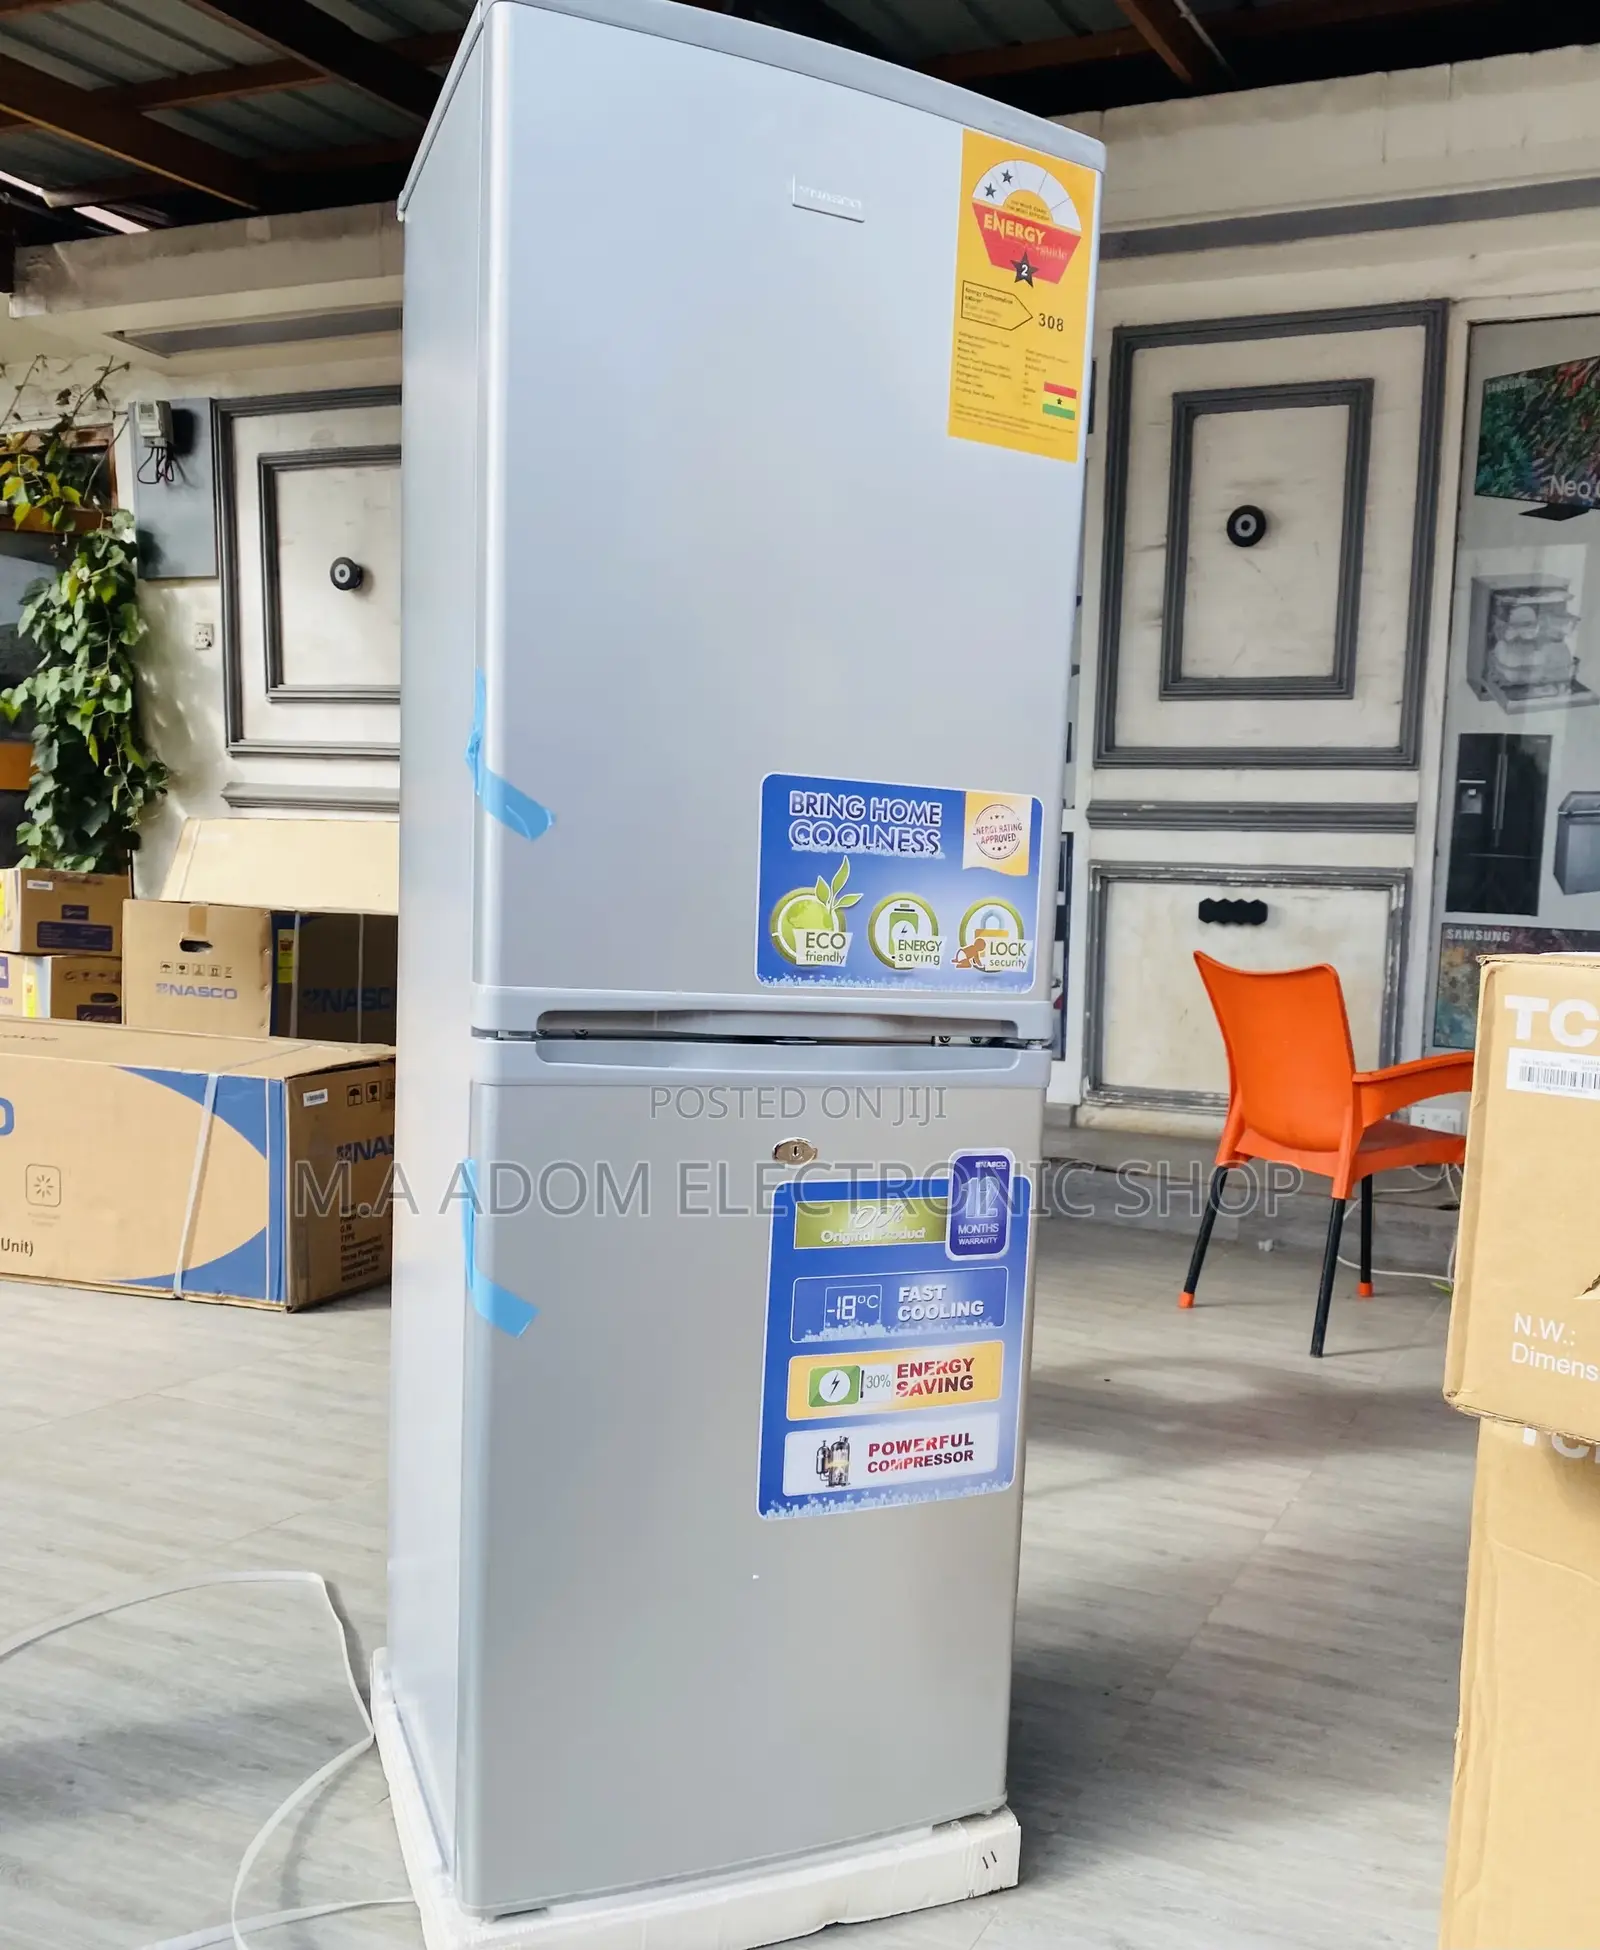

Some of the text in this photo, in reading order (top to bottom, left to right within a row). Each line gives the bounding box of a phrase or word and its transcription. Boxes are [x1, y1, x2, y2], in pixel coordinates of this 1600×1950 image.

[983, 210, 1047, 245] ENERGY
[1021, 264, 1029, 277] 2
[1038, 312, 1064, 332] 308
[790, 790, 942, 826] BRING HOME
[789, 819, 941, 855] COOLNESS
[980, 832, 1017, 844] APPROVED
[805, 932, 847, 949] ECO
[1446, 928, 1511, 943] SAMSUNG
[897, 939, 943, 952] ENERGY
[989, 942, 1027, 957] LOCK
[805, 950, 846, 965] friendly
[897, 953, 941, 966] saving
[988, 956, 1028, 969] security
[169, 983, 238, 1000] NASCO
[820, 1228, 875, 1245] Original
[958, 1223, 1000, 1235] MONTHS
[0, 1237, 34, 1257] Unit)
[958, 1237, 998, 1246] WARRANTY
[898, 1284, 947, 1303] FAST
[897, 1300, 985, 1322] COOLING
[1513, 1312, 1576, 1346] N.W.:
[897, 1357, 976, 1379] ENERGY
[1511, 1341, 1599, 1382] Dimens
[866, 1373, 892, 1390] 30%
[895, 1374, 974, 1398] SAVING
[867, 1432, 974, 1457] POWERFUL
[867, 1449, 974, 1474] COMPRESSOR
